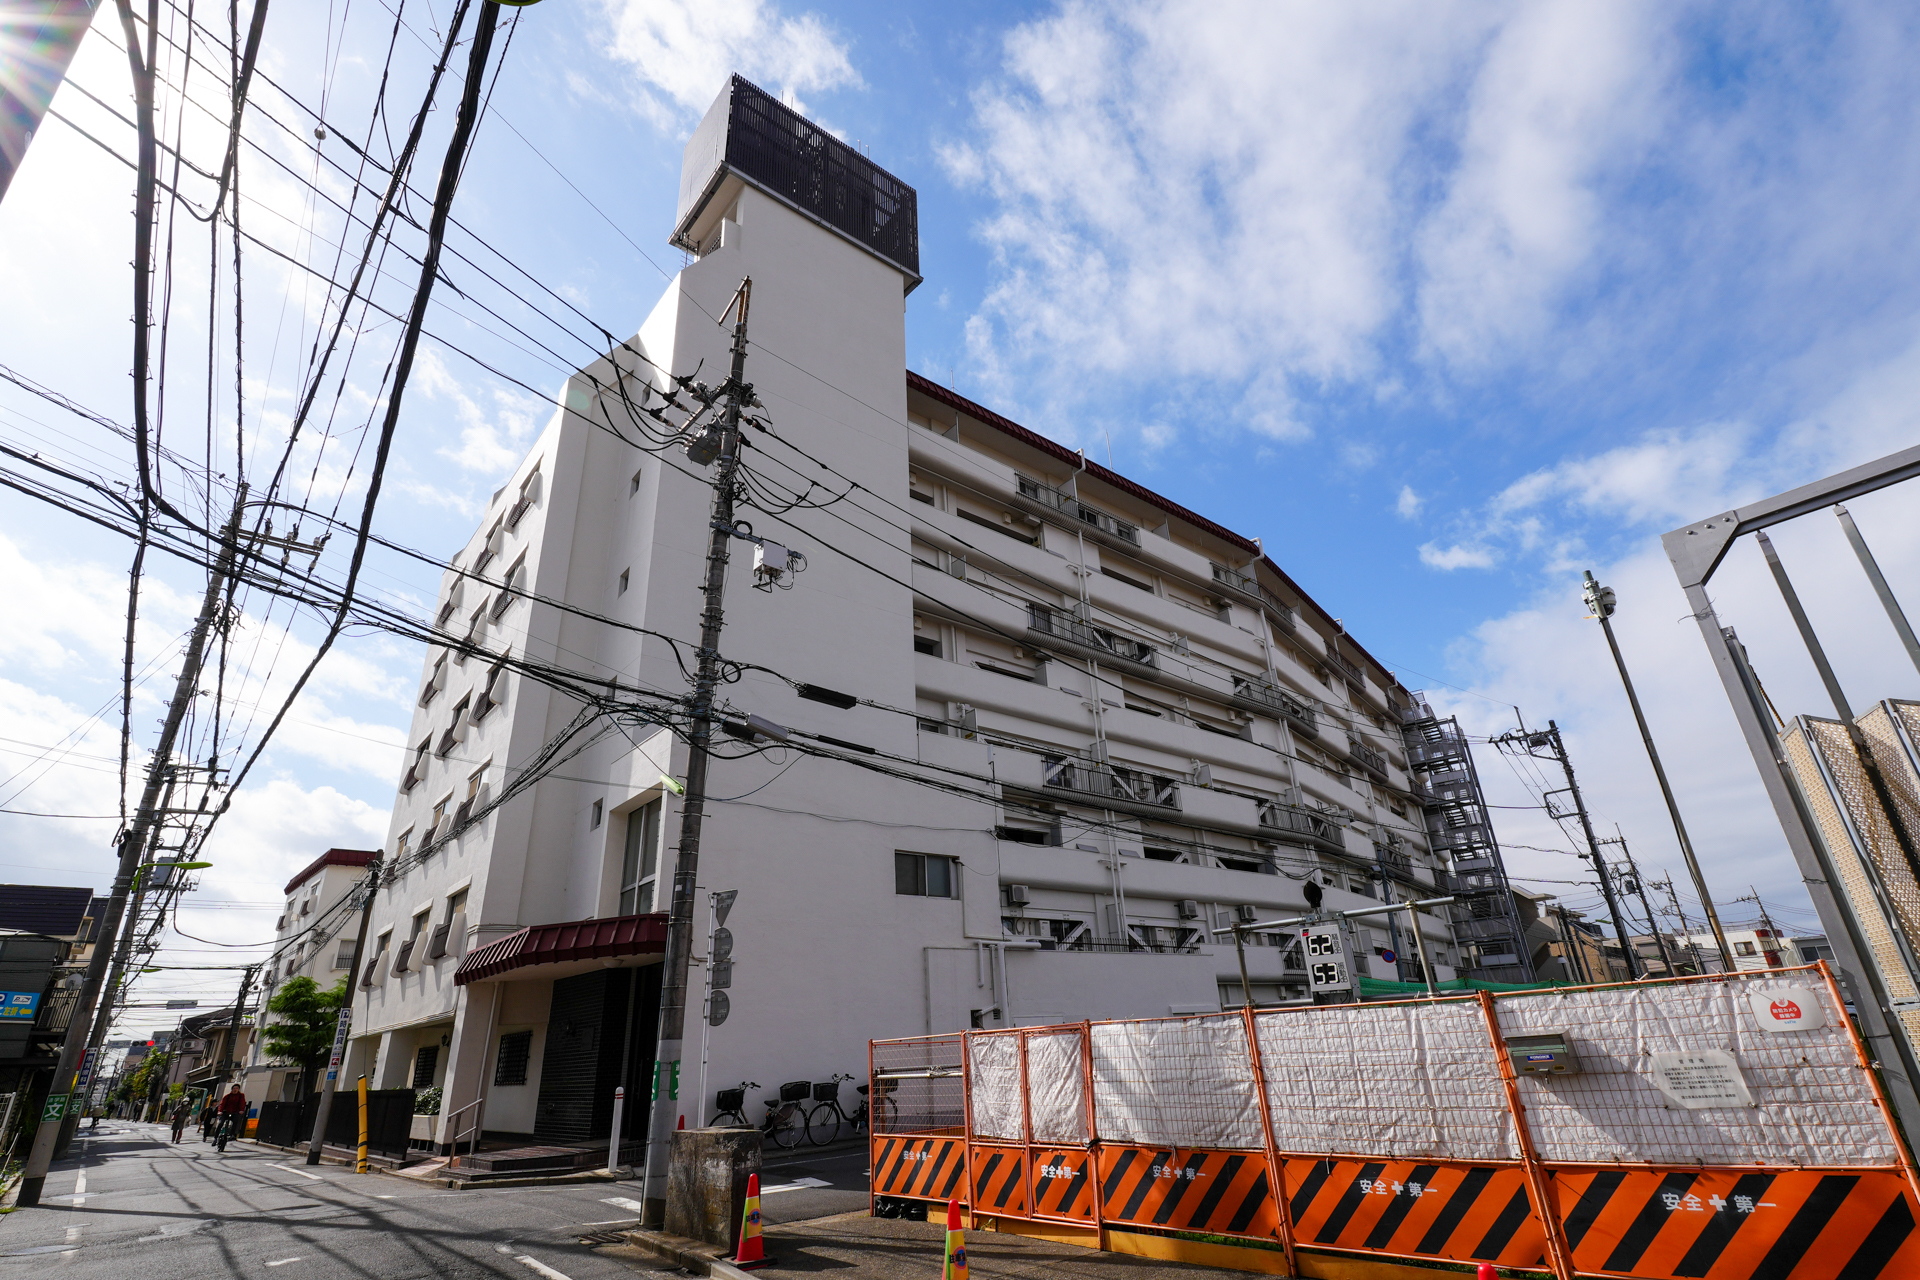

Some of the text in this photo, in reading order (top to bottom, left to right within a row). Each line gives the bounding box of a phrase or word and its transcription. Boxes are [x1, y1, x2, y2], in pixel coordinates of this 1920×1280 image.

[1308, 934, 1331, 955] 62
[1314, 963, 1338, 984] 53
[44, 1103, 63, 1118] 文
[1041, 1164, 1080, 1179] 安全 第一
[1152, 1165, 1206, 1180] 安全 第一
[1360, 1179, 1438, 1197] 安全 第一
[1662, 1193, 1777, 1213] 安全 第一
